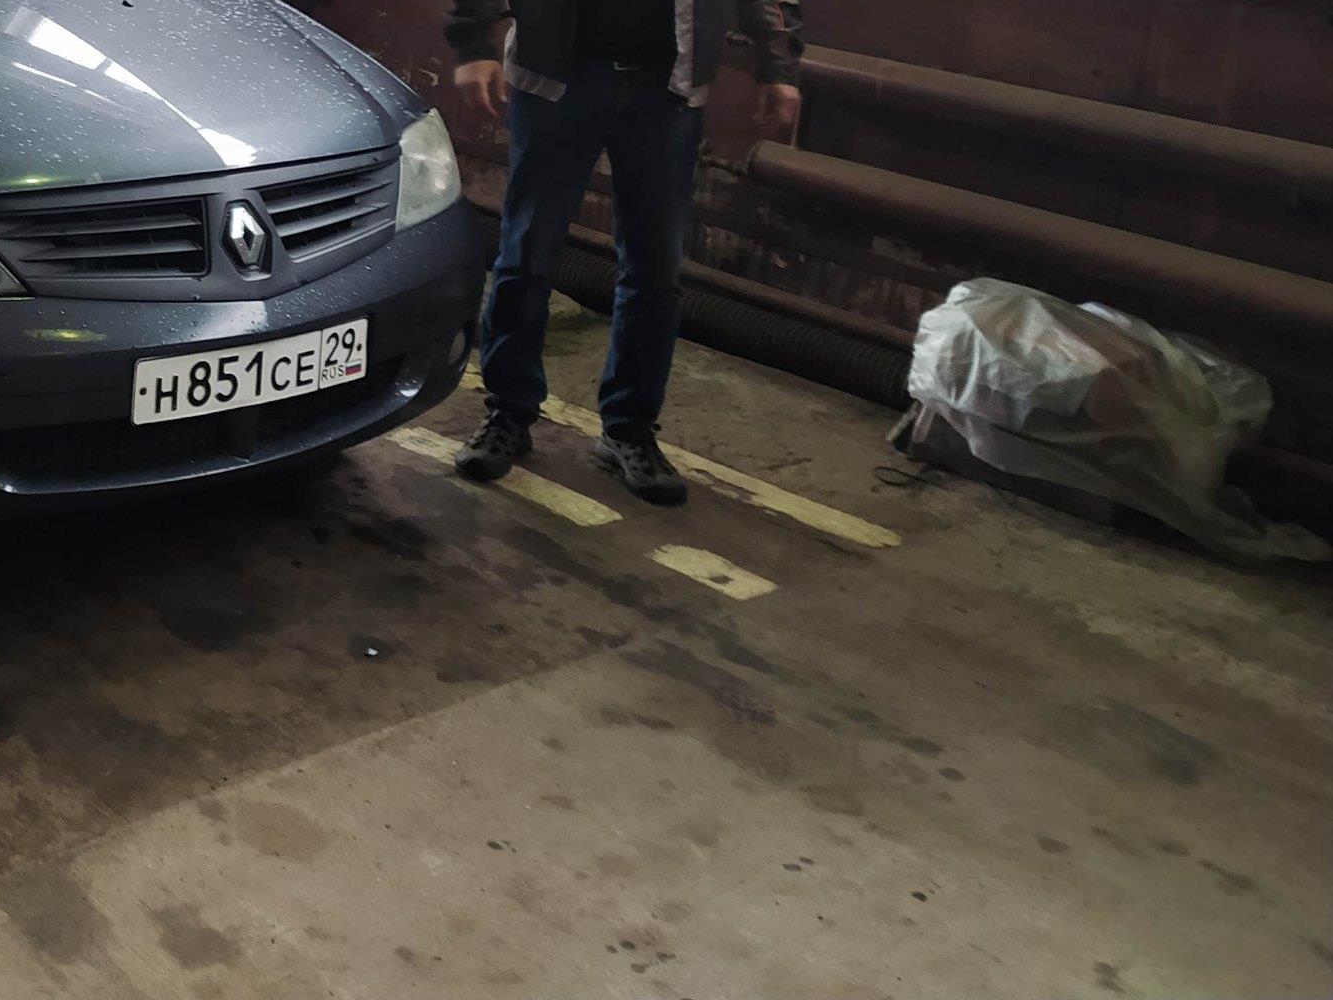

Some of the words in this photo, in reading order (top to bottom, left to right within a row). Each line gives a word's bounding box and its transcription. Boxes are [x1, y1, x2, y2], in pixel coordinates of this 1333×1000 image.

[154, 350, 315, 413] Н851СЕ
[324, 328, 356, 367] 29
[322, 364, 345, 381] RUS
